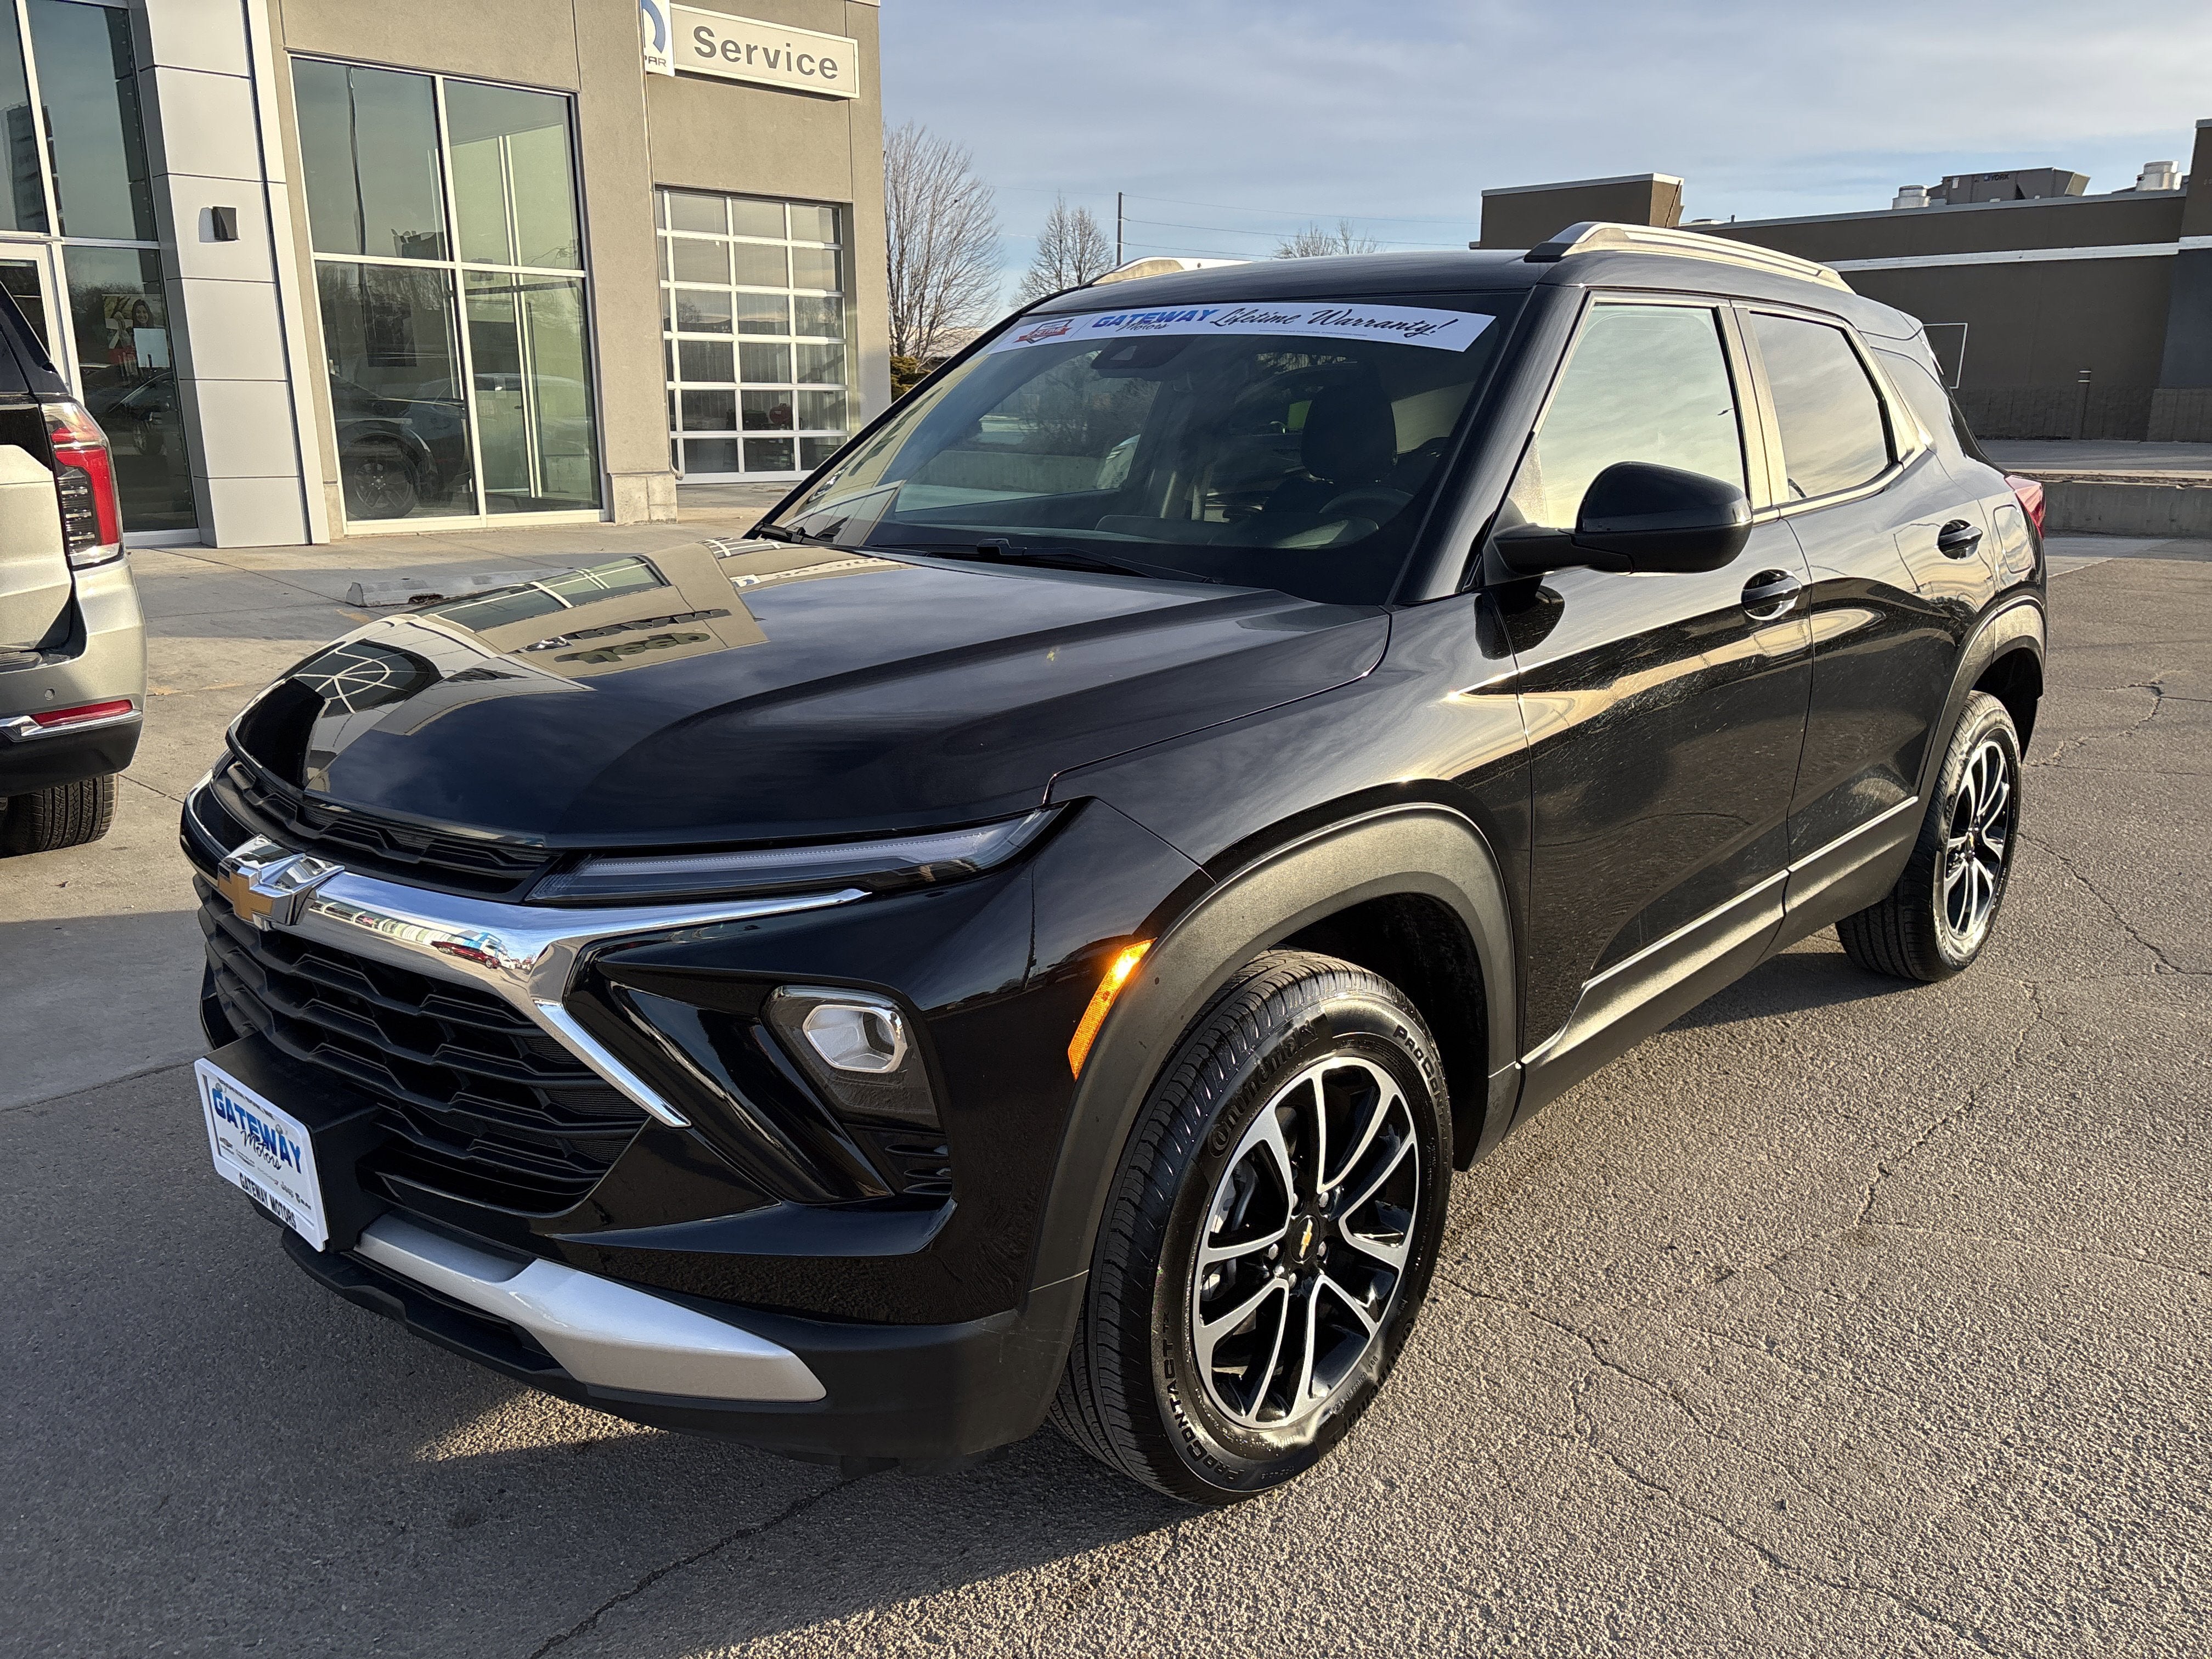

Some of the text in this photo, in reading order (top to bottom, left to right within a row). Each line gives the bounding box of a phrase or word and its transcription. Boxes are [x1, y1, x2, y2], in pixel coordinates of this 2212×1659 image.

[693, 25, 838, 80] Service
[1091, 307, 1459, 338] GATEWAY Lifetime Warranty!
[1115, 319, 1170, 332] Motors
[212, 1087, 302, 1175] GATEWAY
[240, 1130, 282, 1170] Motors
[239, 1172, 297, 1229] GATEWAY MOTORS
